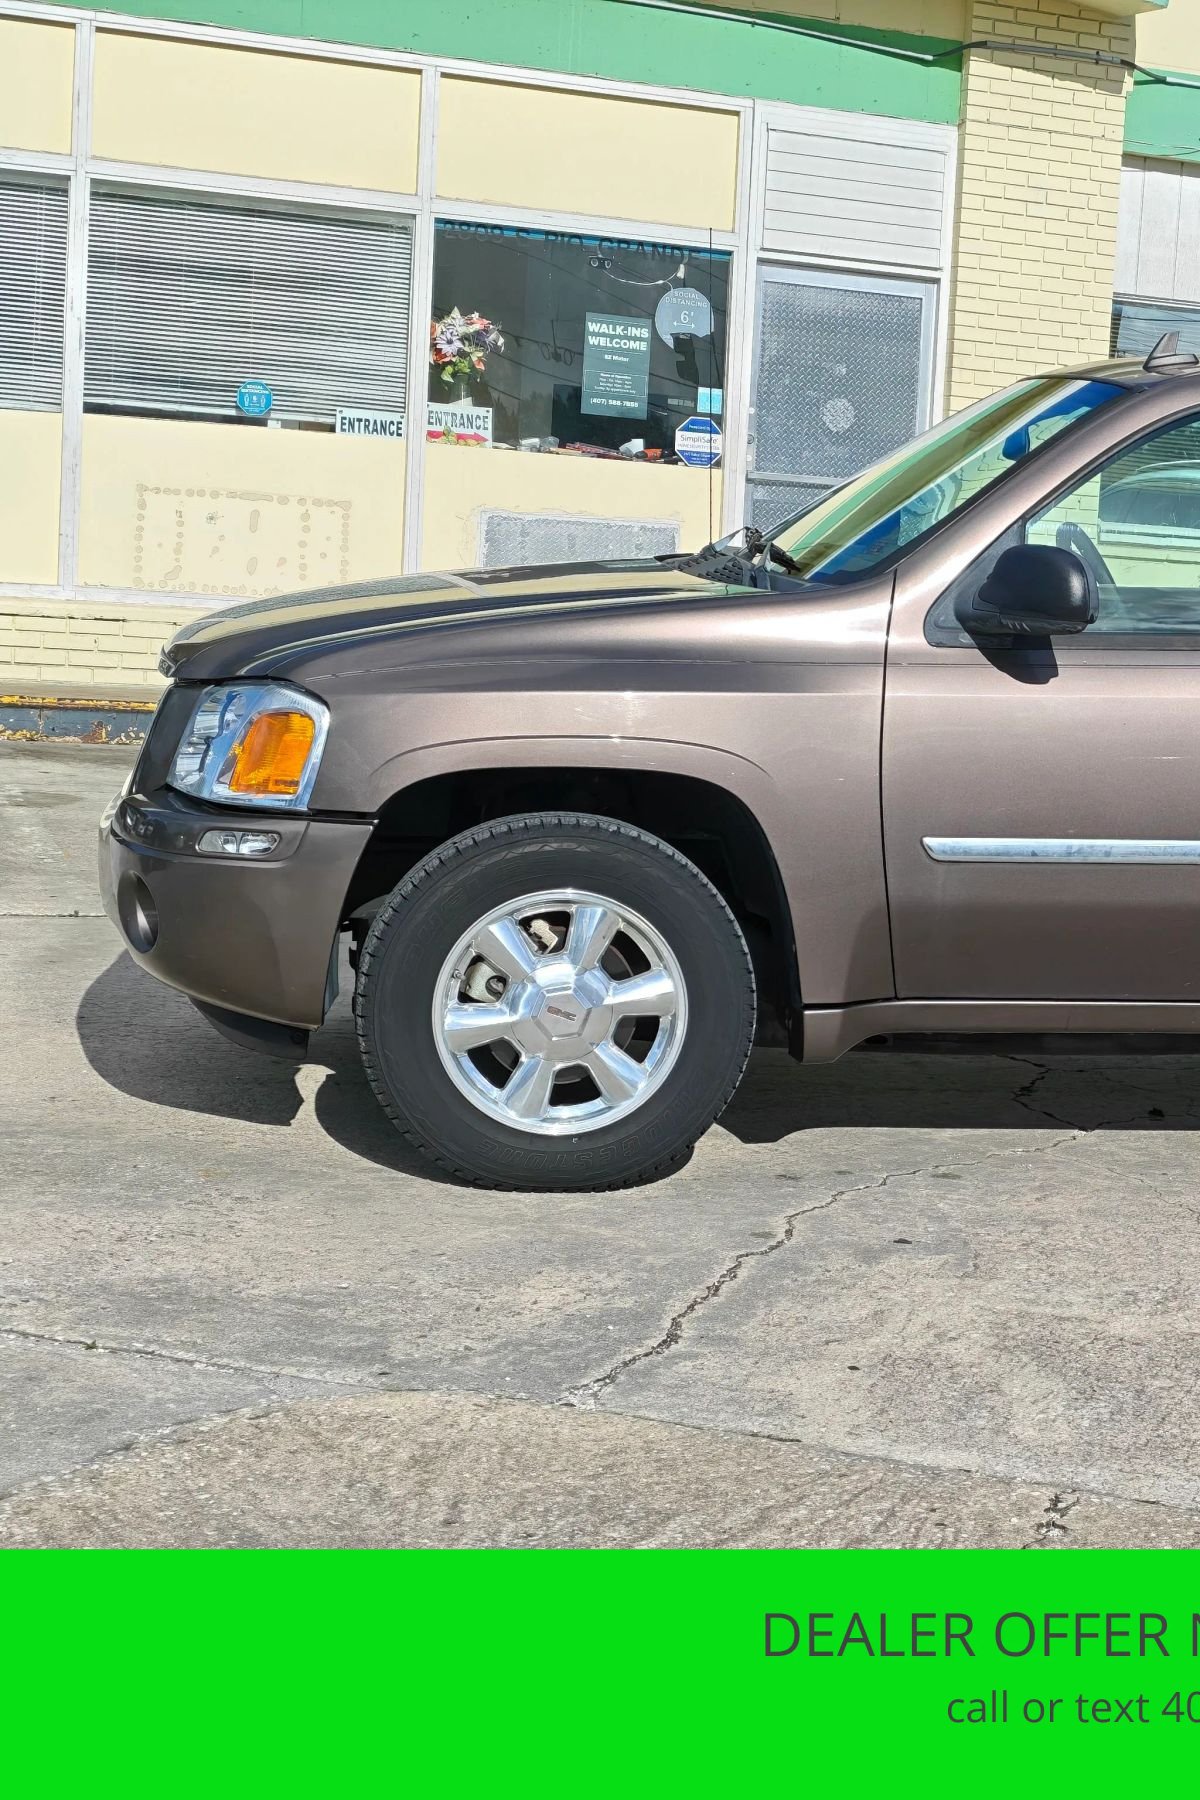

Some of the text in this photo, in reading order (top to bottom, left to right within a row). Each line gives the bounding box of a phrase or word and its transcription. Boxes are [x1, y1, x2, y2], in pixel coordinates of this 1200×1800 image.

[665, 297, 708, 308] DISTANCING
[674, 291, 700, 300] SOCIAL
[587, 321, 649, 338] WALK-INS
[587, 335, 648, 351] WELCOME
[340, 416, 403, 437] ENTRANCE
[427, 409, 489, 431] ENTRANCE
